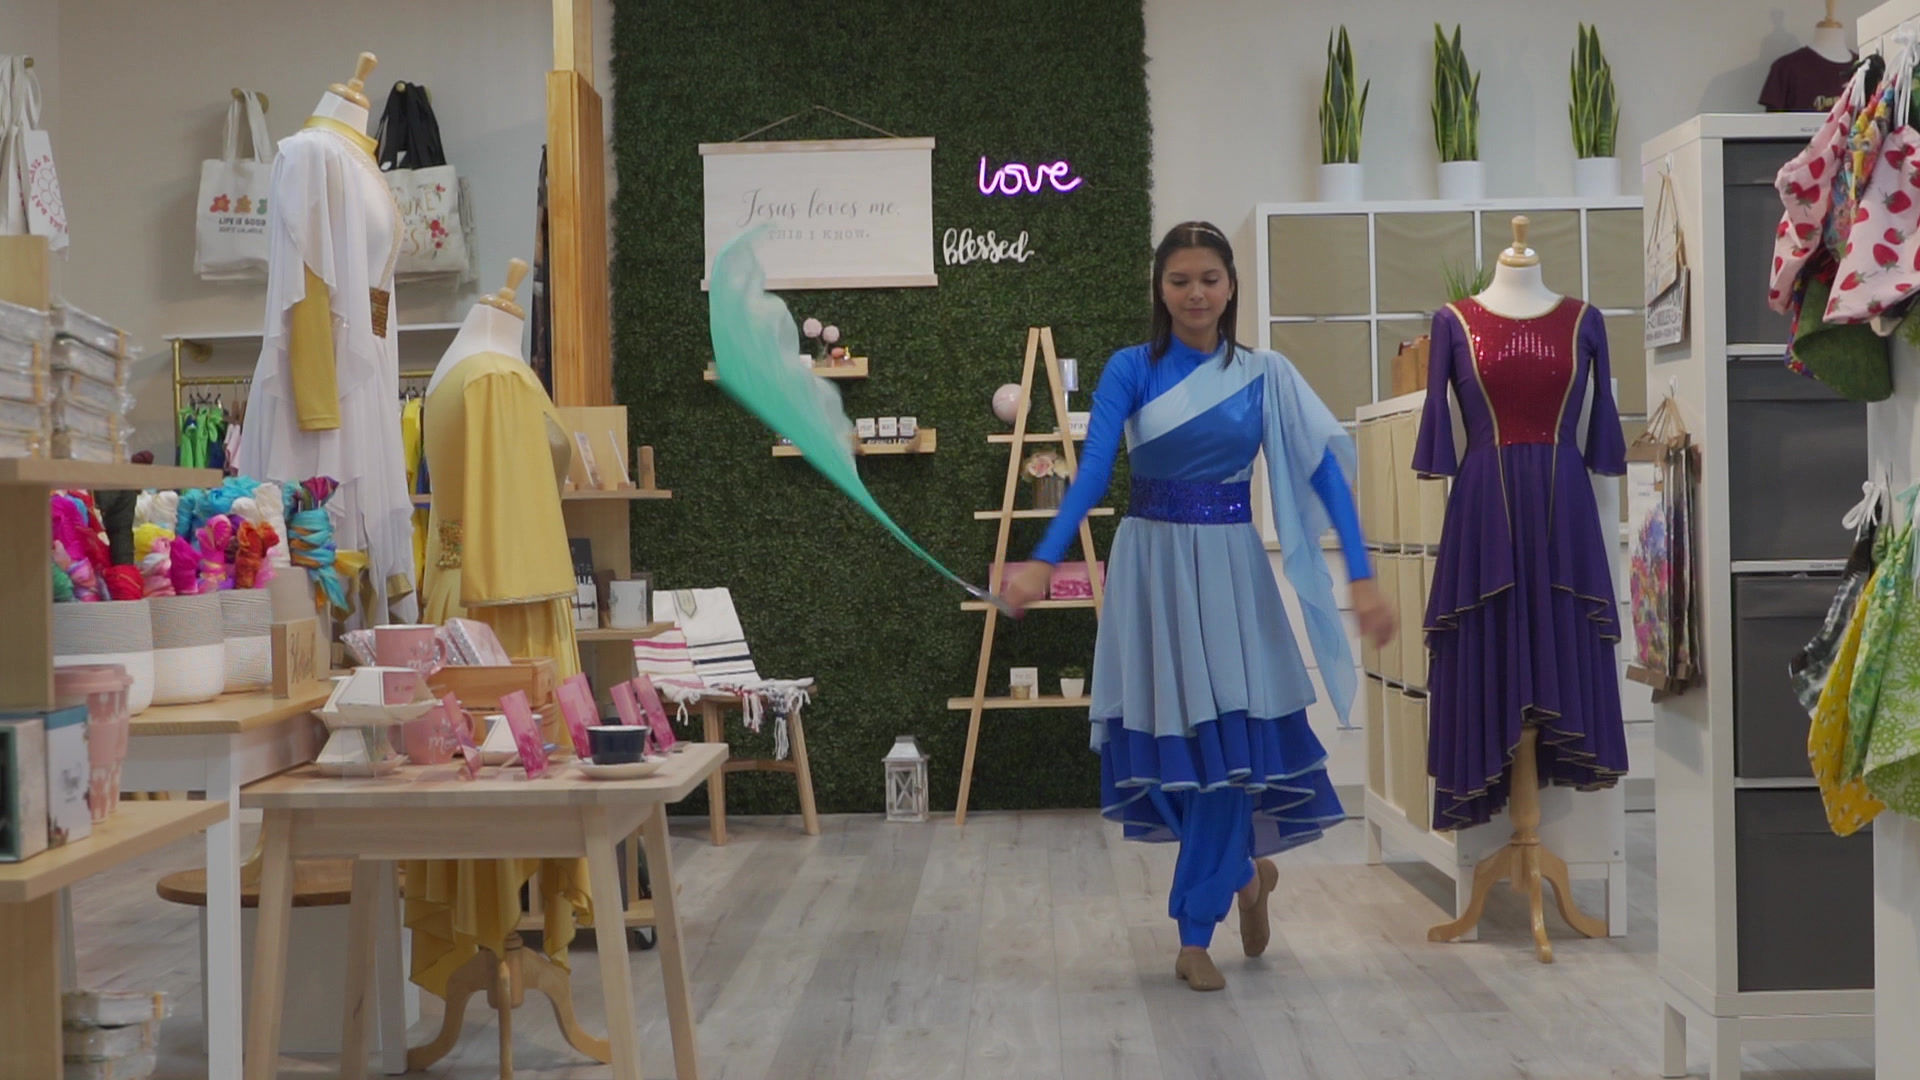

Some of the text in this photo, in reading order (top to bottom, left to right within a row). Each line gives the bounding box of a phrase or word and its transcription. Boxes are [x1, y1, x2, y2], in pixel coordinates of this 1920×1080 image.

[978, 155, 1083, 196] love
[736, 187, 798, 229] Jesus
[808, 187, 859, 219] loves
[767, 228, 802, 241] THIS
[942, 228, 1035, 266] blessed
